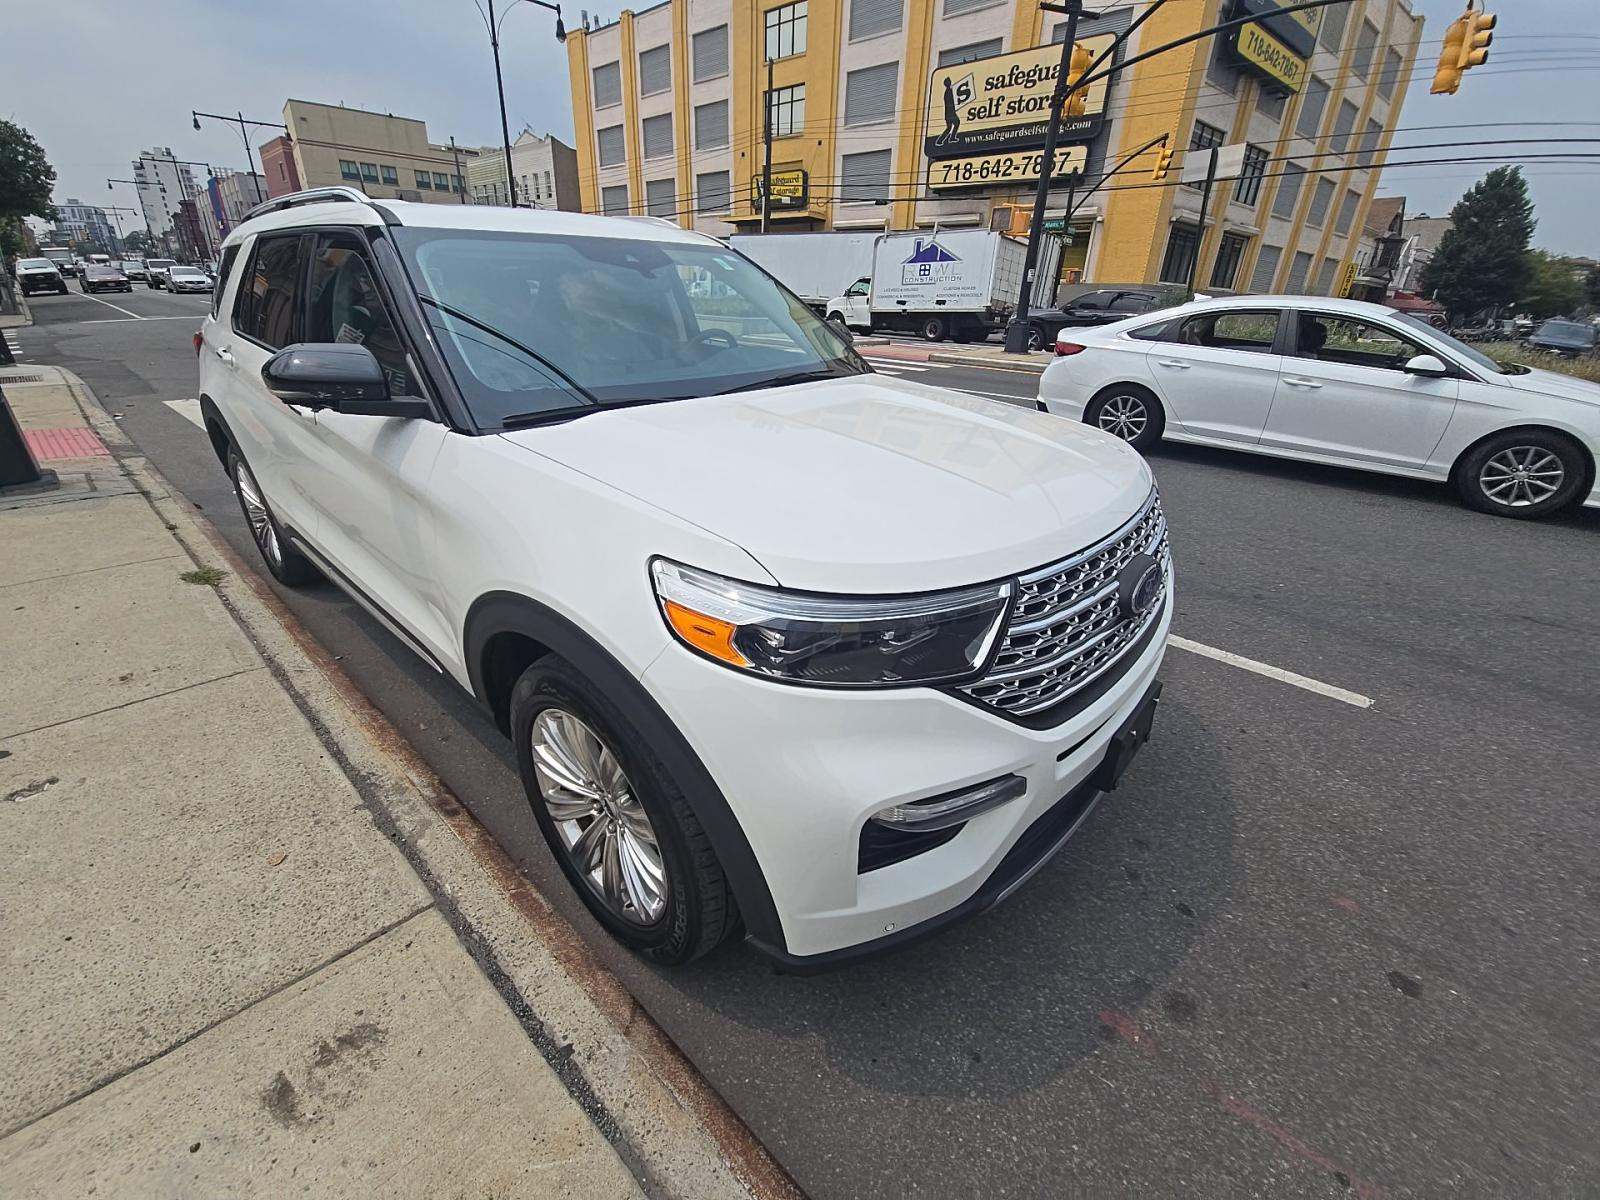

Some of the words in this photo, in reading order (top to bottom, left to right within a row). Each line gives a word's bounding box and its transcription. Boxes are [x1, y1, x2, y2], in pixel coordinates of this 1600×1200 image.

[984, 64, 1062, 92] safegua
[966, 97, 1005, 122] self
[1006, 93, 1053, 116] stor
[904, 275, 962, 283] CONSTRUCTION
